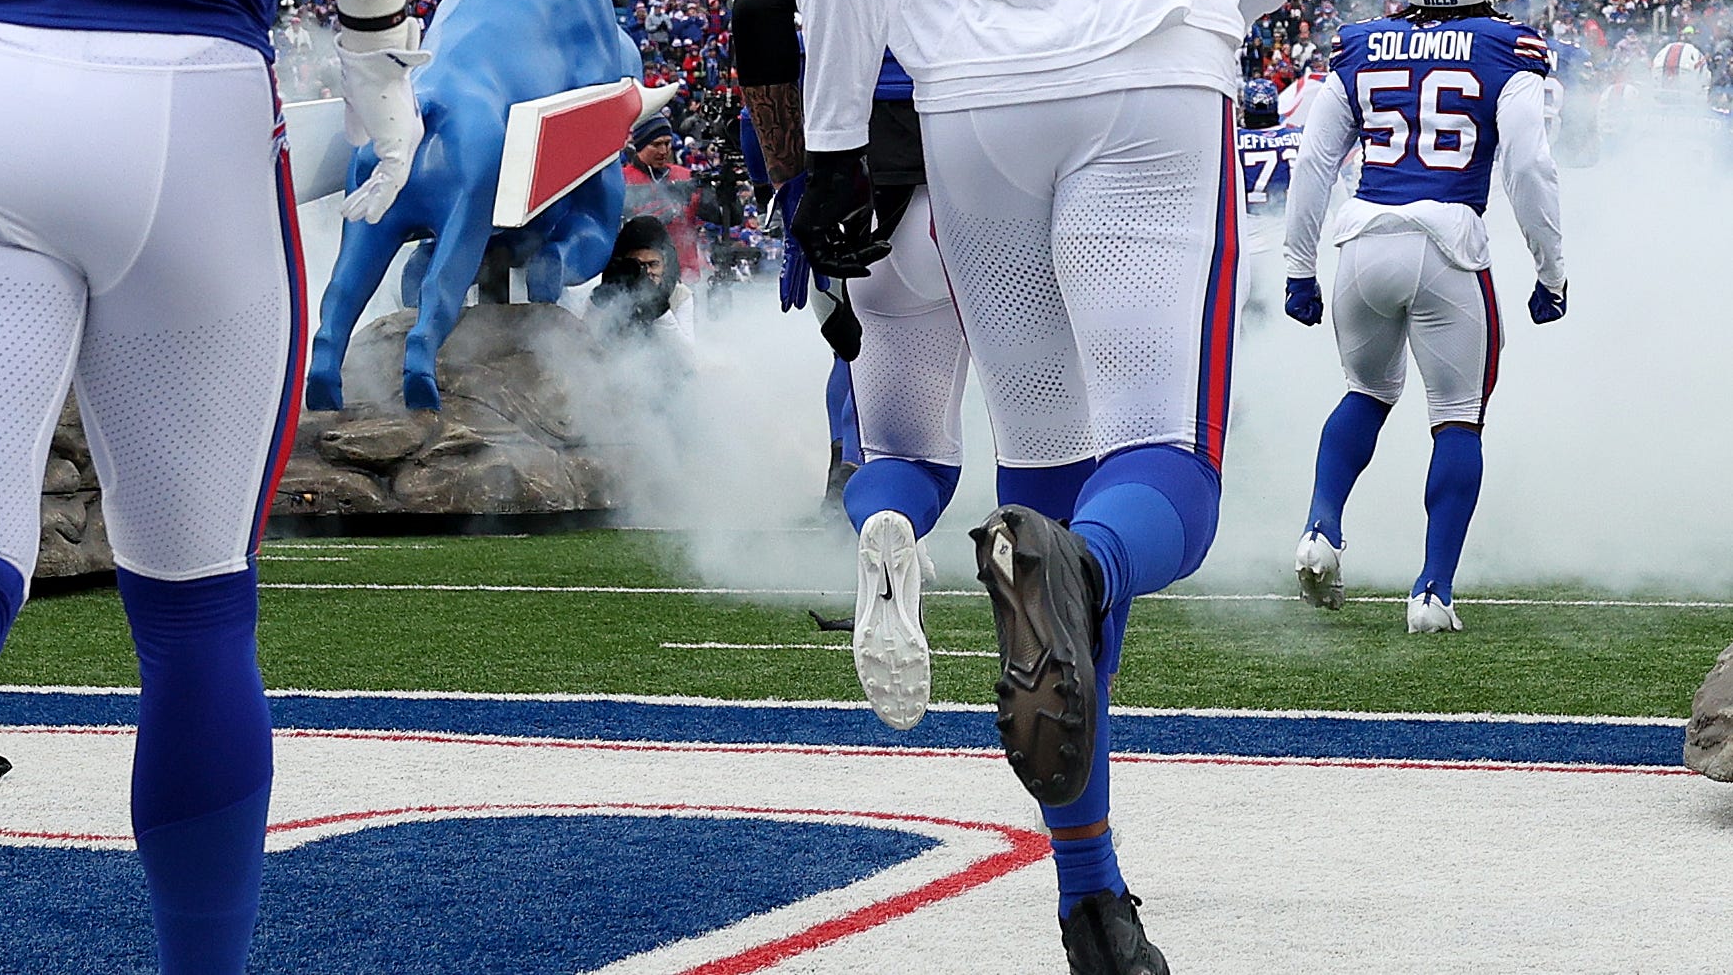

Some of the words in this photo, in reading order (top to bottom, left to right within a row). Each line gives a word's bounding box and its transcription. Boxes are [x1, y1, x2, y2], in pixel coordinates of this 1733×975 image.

[1367, 30, 1474, 61] SOLOMON
[1356, 68, 1484, 171] 56
[1237, 132, 1303, 149] JEFFERSO
